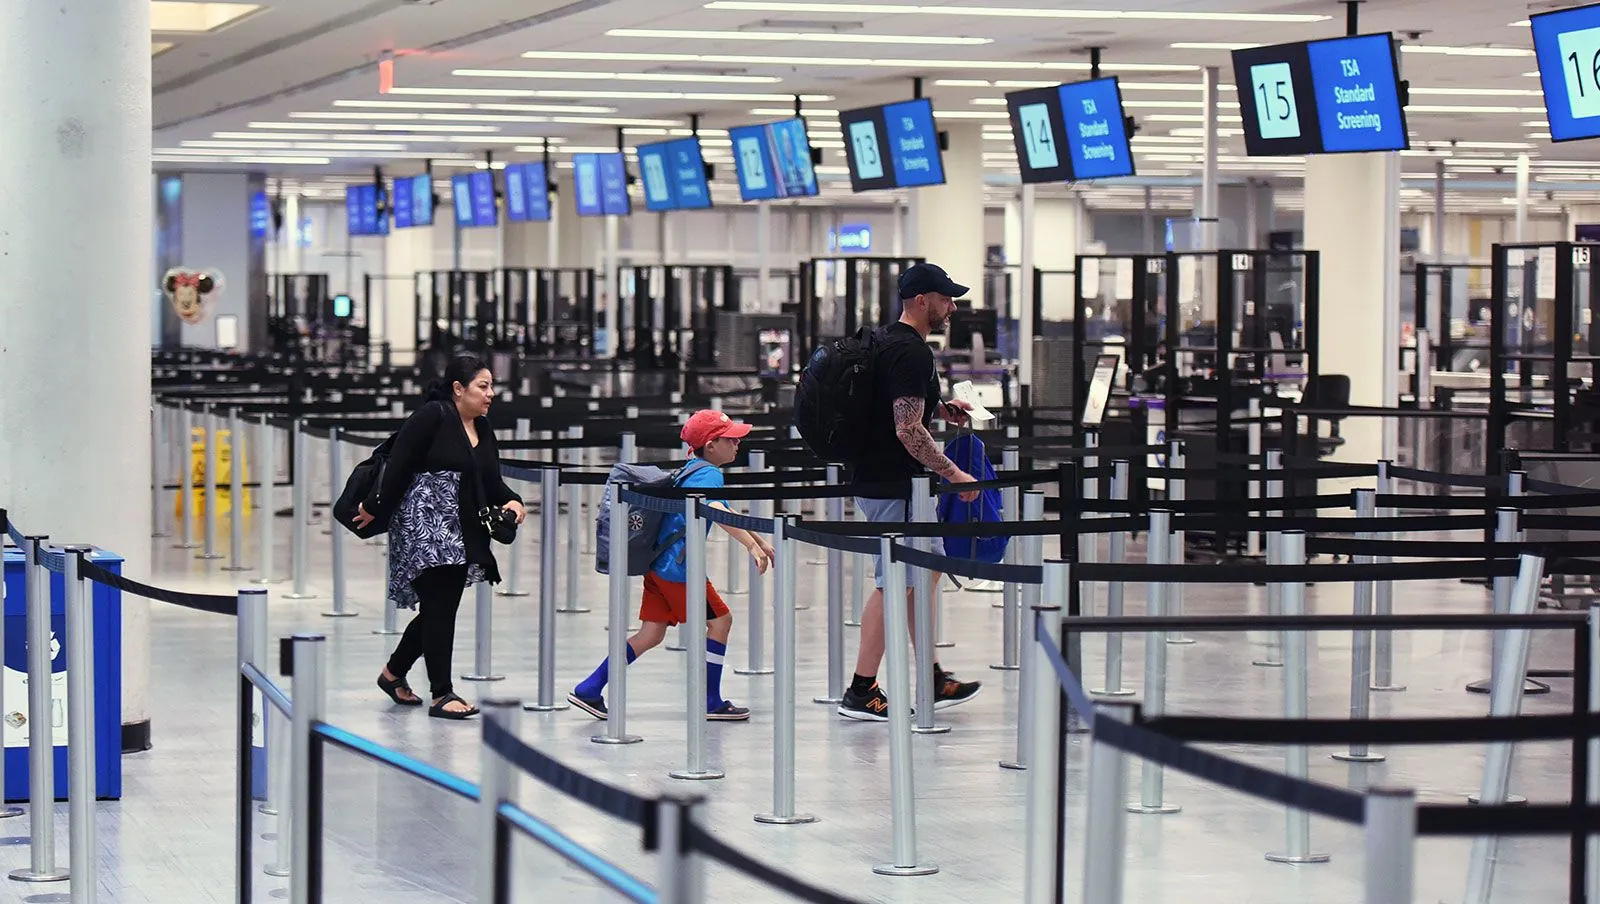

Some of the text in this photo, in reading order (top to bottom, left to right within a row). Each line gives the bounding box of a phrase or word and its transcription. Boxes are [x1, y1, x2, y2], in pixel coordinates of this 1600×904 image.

[1340, 58, 1361, 77] TSA
[1258, 81, 1291, 121] 15
[1334, 83, 1376, 104] Standard
[1336, 110, 1382, 132] Screening
[1026, 119, 1052, 154] 14
[856, 135, 877, 165] 13
[743, 149, 762, 177] 12
[1235, 256, 1247, 269] 14
[1575, 247, 1588, 262] 15
